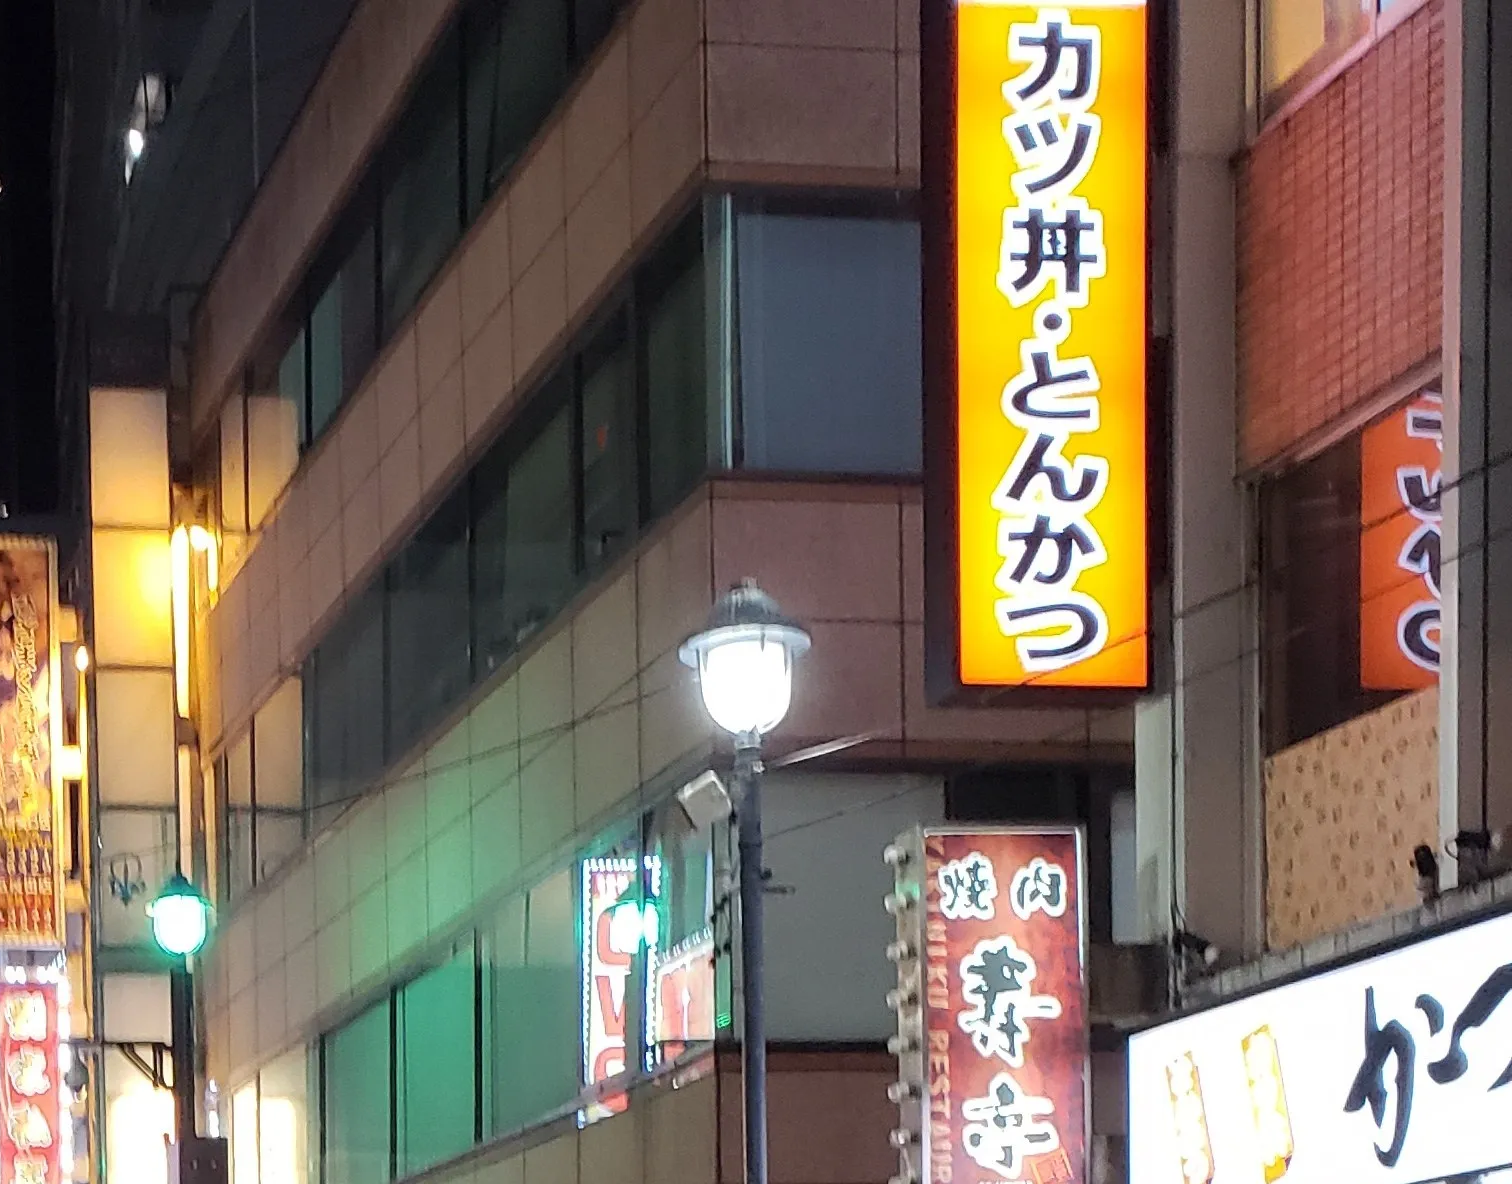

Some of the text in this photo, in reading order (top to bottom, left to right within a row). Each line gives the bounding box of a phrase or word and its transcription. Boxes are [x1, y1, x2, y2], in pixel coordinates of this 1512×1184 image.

[1004, 20, 1100, 660] カツ丼・とんかつ
